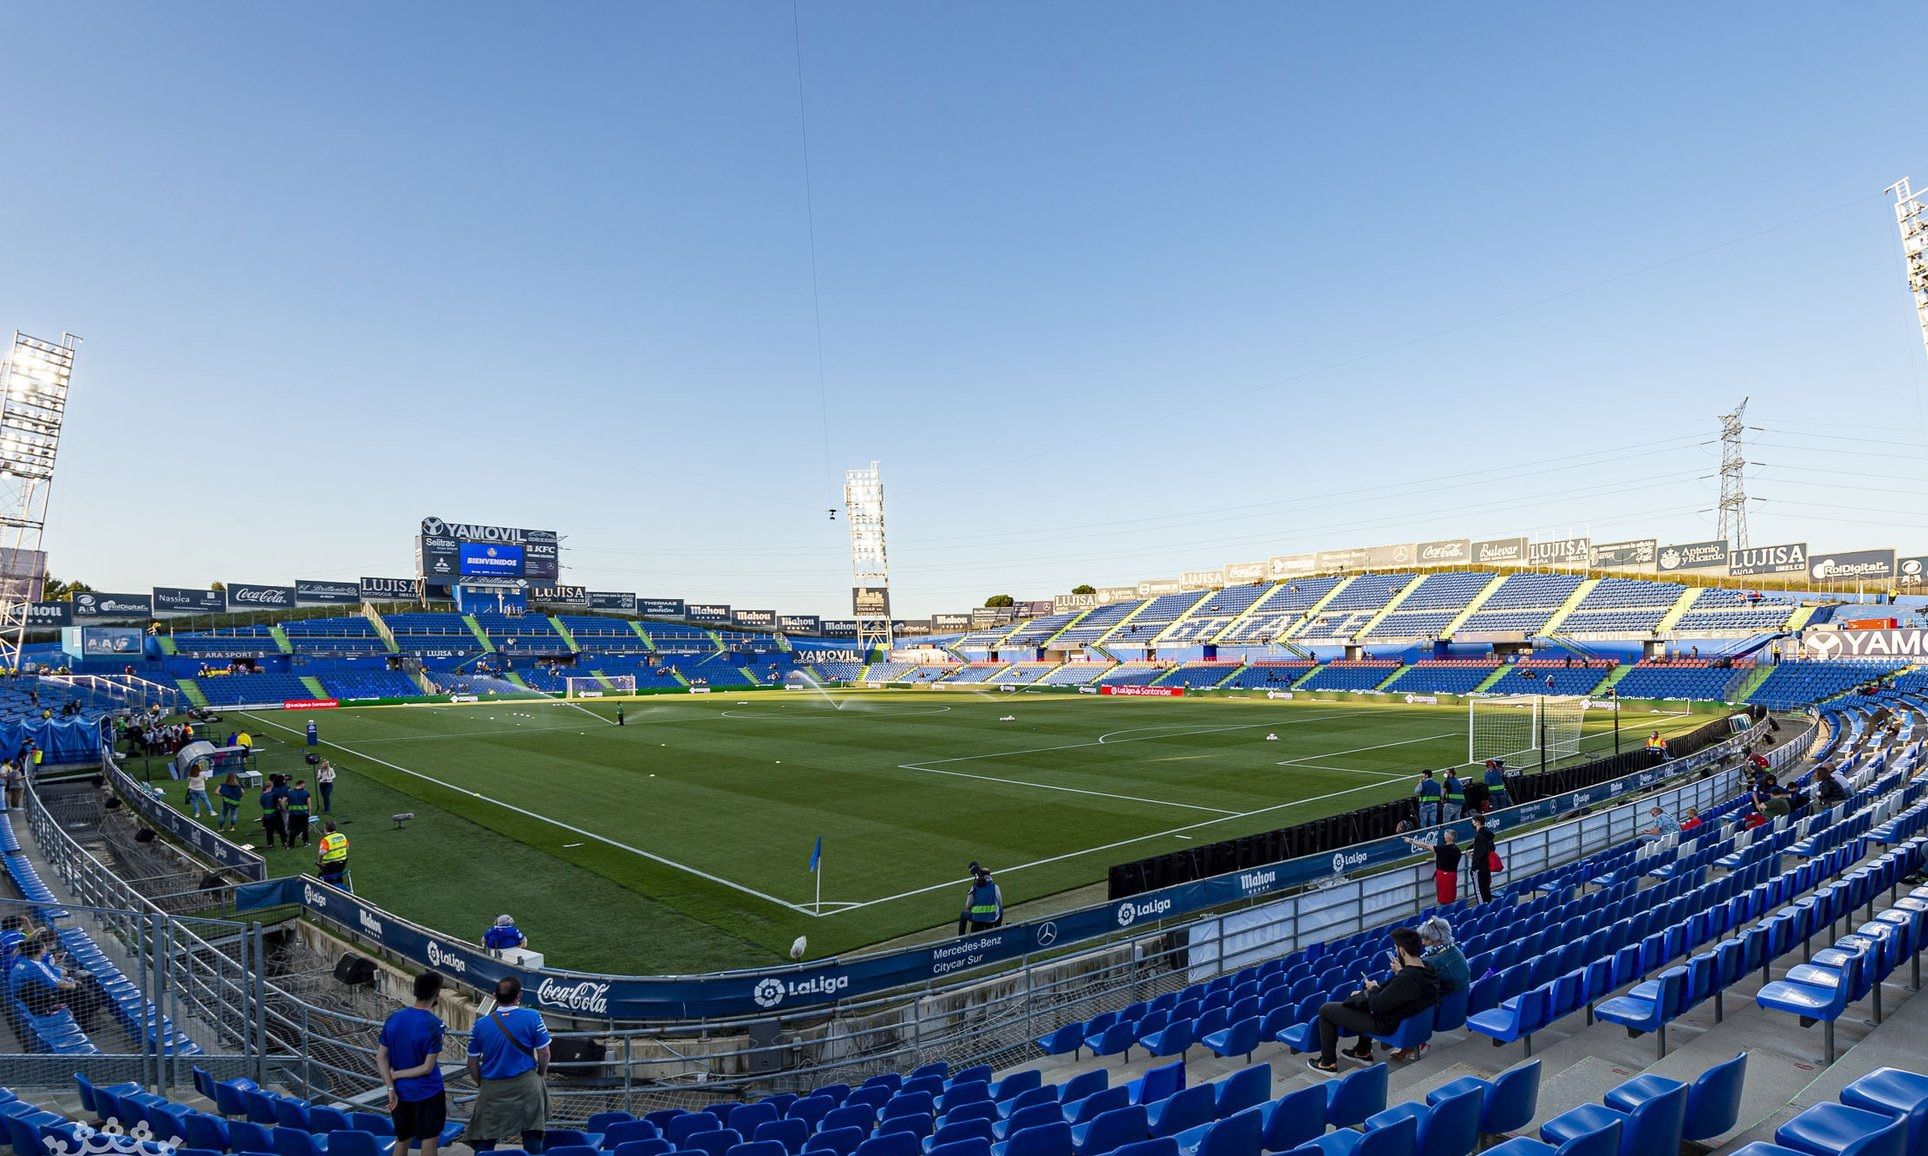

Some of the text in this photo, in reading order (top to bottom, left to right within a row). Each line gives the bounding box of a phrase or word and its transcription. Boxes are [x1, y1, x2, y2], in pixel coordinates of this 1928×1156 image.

[445, 523, 527, 542] YAMOVIL
[426, 538, 456, 547] Selitrac
[534, 545, 556, 553] KFC
[1530, 540, 1588, 559] LUJISA
[1423, 543, 1462, 558] Coca-Cola
[1480, 543, 1518, 558] Bulevar
[1681, 544, 1720, 557] Antonio
[1688, 551, 1725, 563] Ricardo
[1730, 545, 1804, 569] LUJISA
[467, 557, 517, 566] BIENVENIDOS
[362, 578, 417, 593] LUJISA
[535, 587, 584, 598] LUJISA
[159, 591, 190, 603] Nassica
[236, 587, 285, 603] Coca-Cola
[1055, 595, 1095, 606] LUJISA
[690, 605, 726, 615] Mahou
[736, 611, 771, 621] Mahou
[781, 617, 815, 626] Mahou
[825, 621, 857, 631] Mahou
[937, 615, 968, 625] Mahou
[798, 650, 855, 661] YAMOVIL
[1345, 851, 1367, 866] LaLiga
[1240, 870, 1277, 890] Mahou
[311, 890, 326, 907] LaLiga
[1137, 898, 1171, 916] LaLiga
[360, 909, 383, 935] Mahou
[934, 935, 1002, 960] Mercedes-Benz
[440, 949, 465, 972] LaLiga
[933, 953, 984, 974] Citycar Sur
[789, 975, 848, 996] LaLiga
[537, 977, 610, 1014] Coca-Cola
